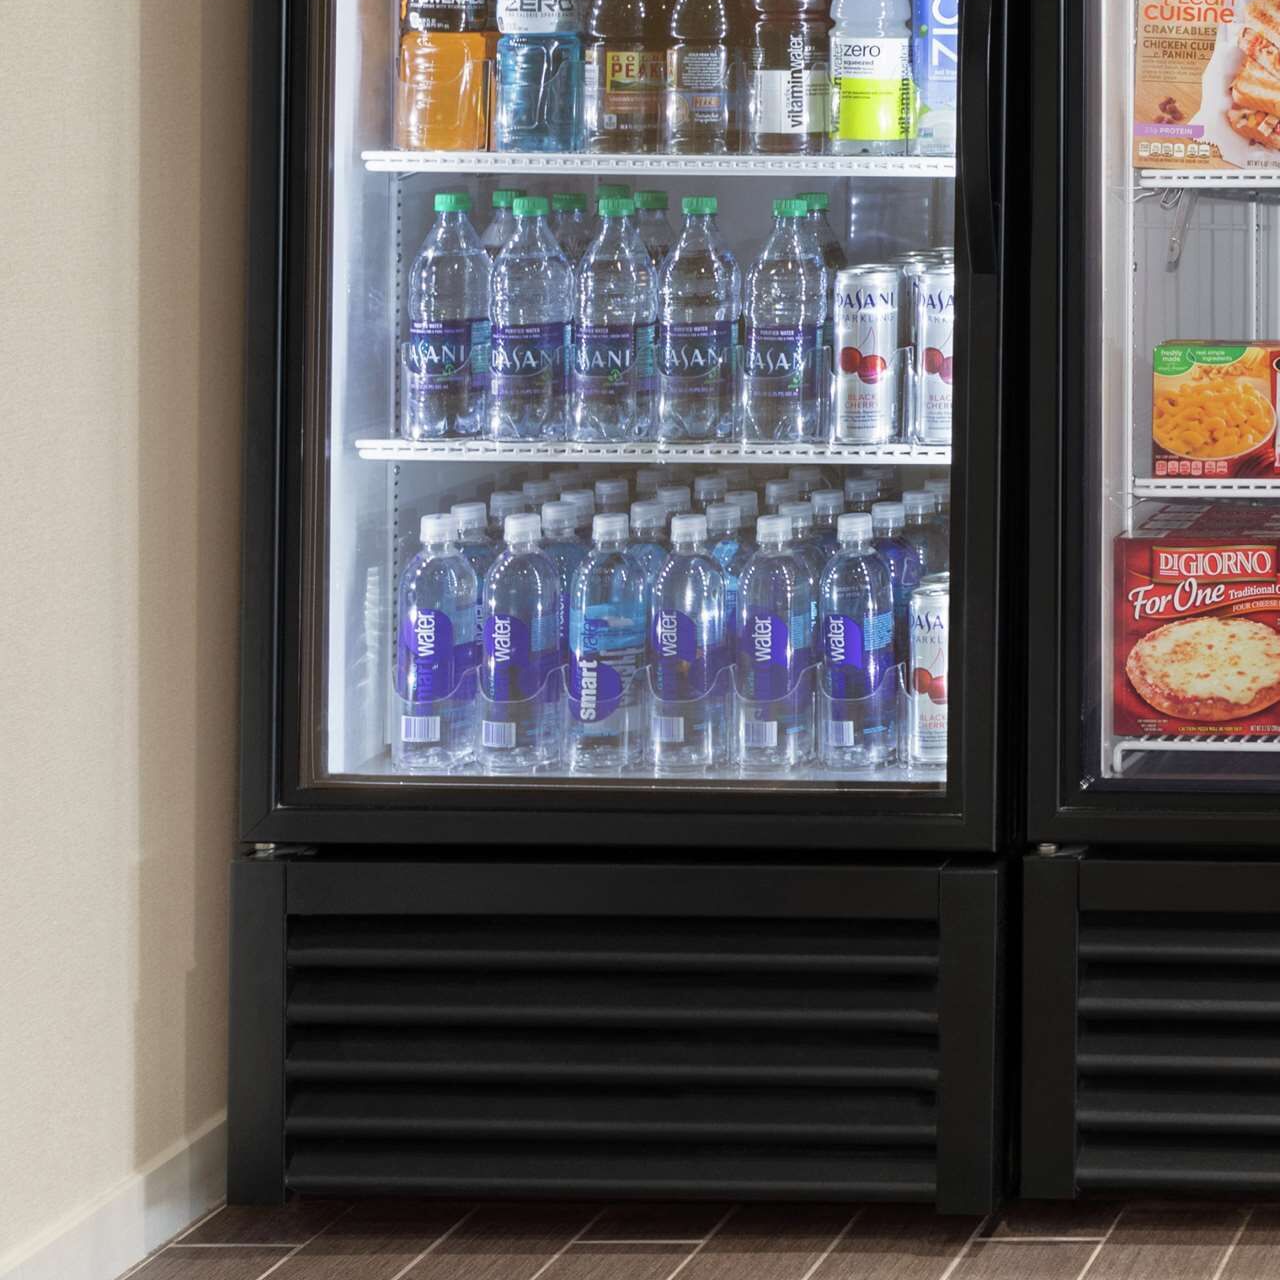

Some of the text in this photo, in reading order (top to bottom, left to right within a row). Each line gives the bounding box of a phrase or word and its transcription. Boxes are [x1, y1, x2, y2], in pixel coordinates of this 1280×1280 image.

[843, 45, 880, 57] zero
[1143, 40, 1215, 51] CHICKEN CLUB
[1144, 25, 1217, 35] CRAVEABLES
[1162, 50, 1197, 60] PANINI
[788, 33, 804, 128] vitaminwater
[1160, 127, 1192, 135] PROTEIN
[1128, 578, 1225, 620] For One
[1229, 585, 1275, 599] Traditional
[1232, 604, 1251, 612] FOUR
[1252, 601, 1278, 609] CHEESE
[414, 611, 436, 656] water
[492, 616, 510, 662] water
[662, 611, 678, 657] water
[755, 616, 772, 661] water
[829, 616, 846, 661] water
[580, 660, 598, 720] smart
